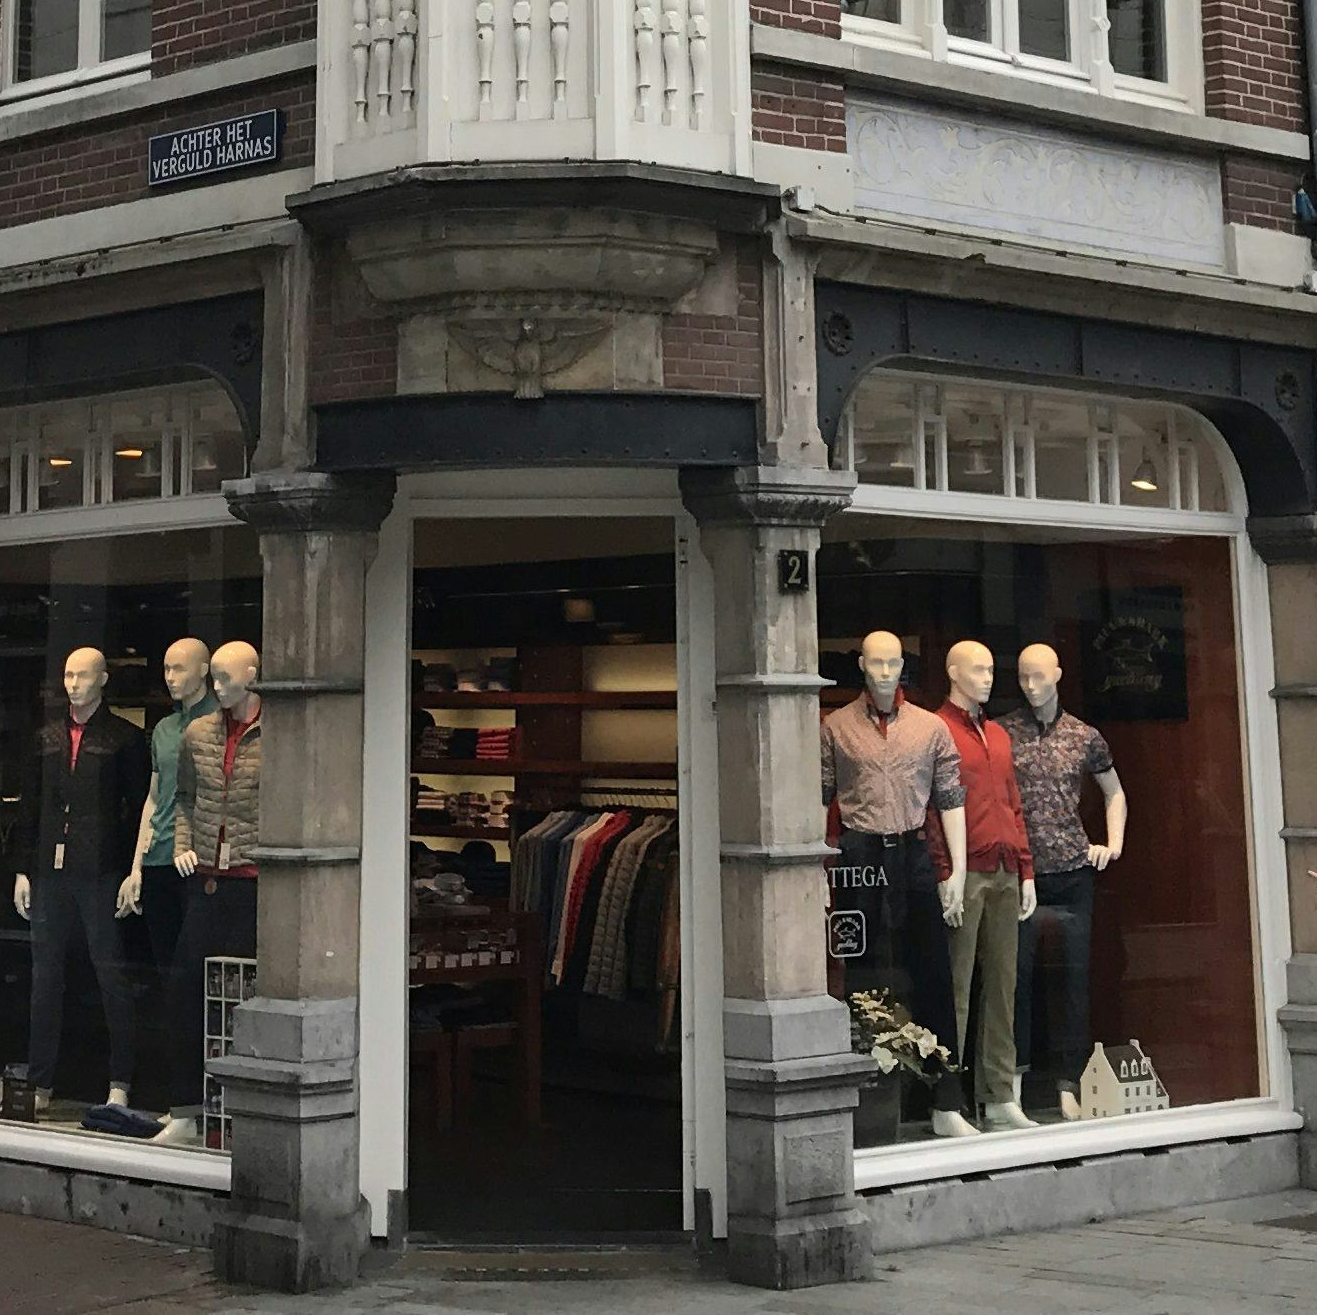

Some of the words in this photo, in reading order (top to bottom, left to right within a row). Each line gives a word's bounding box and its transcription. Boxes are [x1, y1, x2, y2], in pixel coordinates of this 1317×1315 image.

[170, 127, 222, 156] ACHTER
[226, 119, 253, 143] HET
[152, 150, 212, 179] VERGULD
[216, 136, 272, 165] HARNAS
[787, 555, 802, 584] 2
